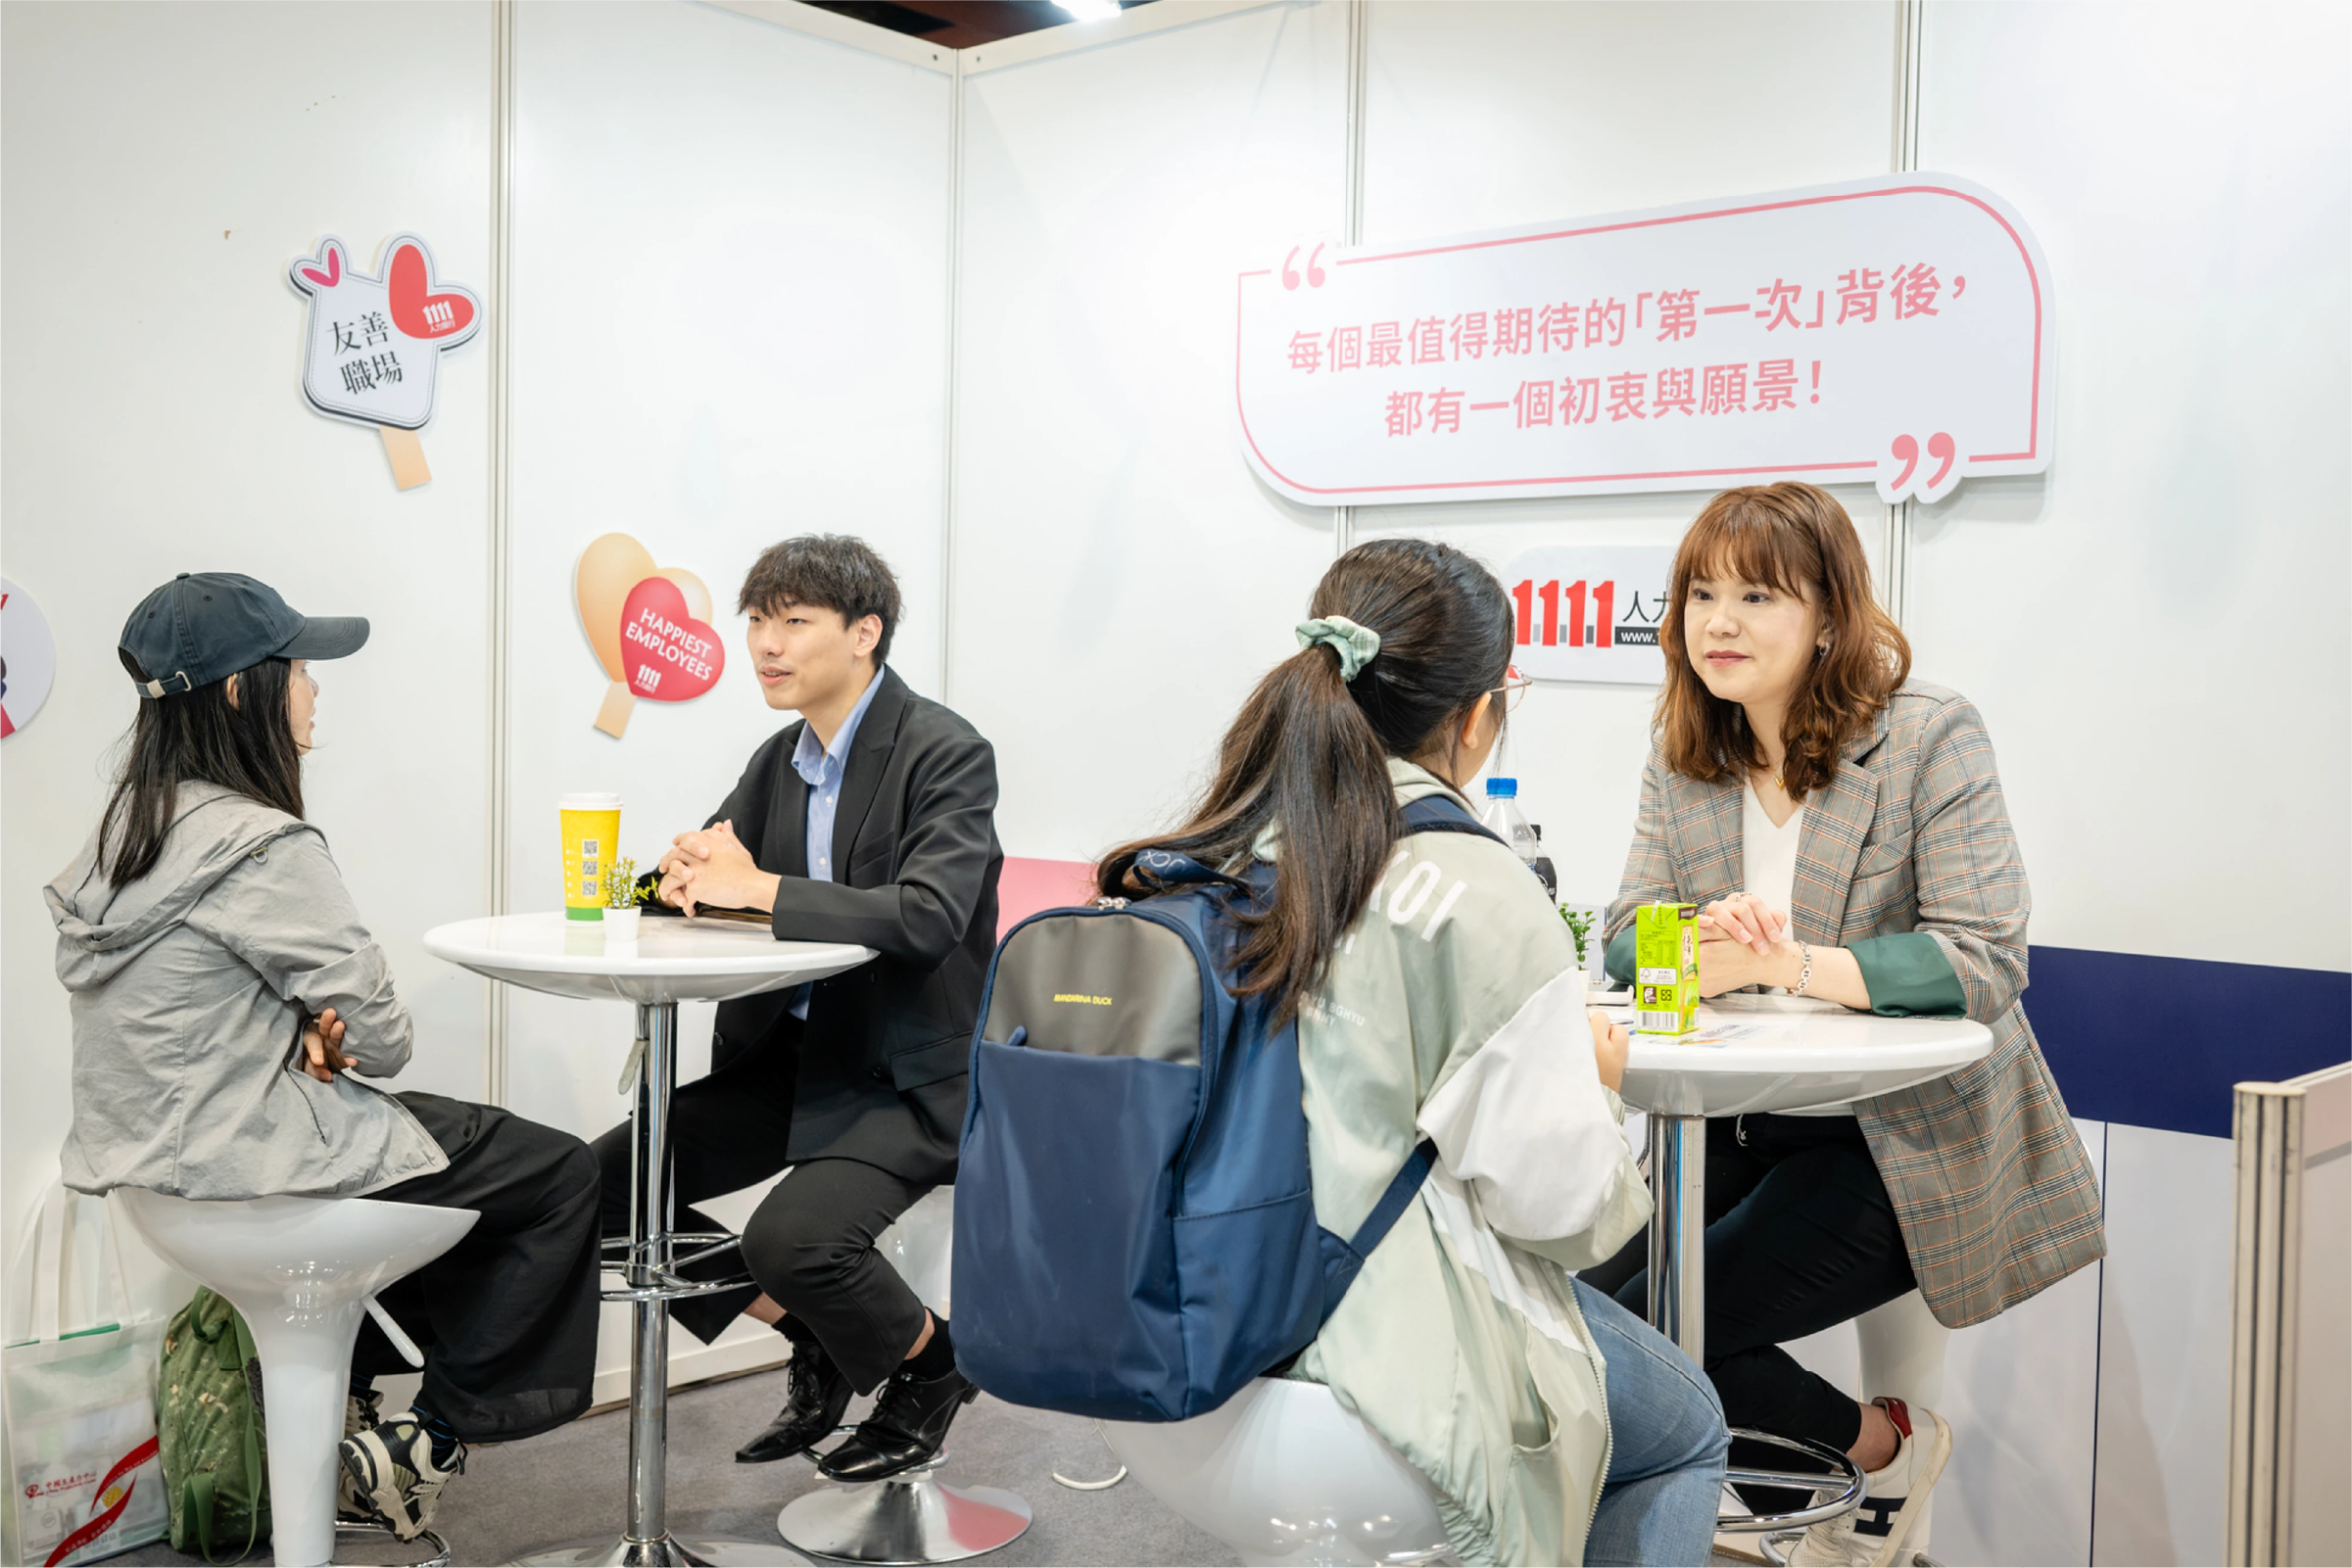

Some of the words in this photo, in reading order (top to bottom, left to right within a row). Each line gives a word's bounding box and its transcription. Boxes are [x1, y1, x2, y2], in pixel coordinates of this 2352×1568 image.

[326, 311, 389, 356] 友善
[422, 301, 454, 325] 1111
[339, 351, 403, 395] 職場
[640, 607, 712, 659] HAPPIEST
[1512, 579, 1614, 648] 1111
[626, 621, 713, 682] EMPLOYEES
[1621, 631, 1659, 643] www.
[638, 664, 662, 688] 1111
[1092, 994, 1113, 1006] DUCK
